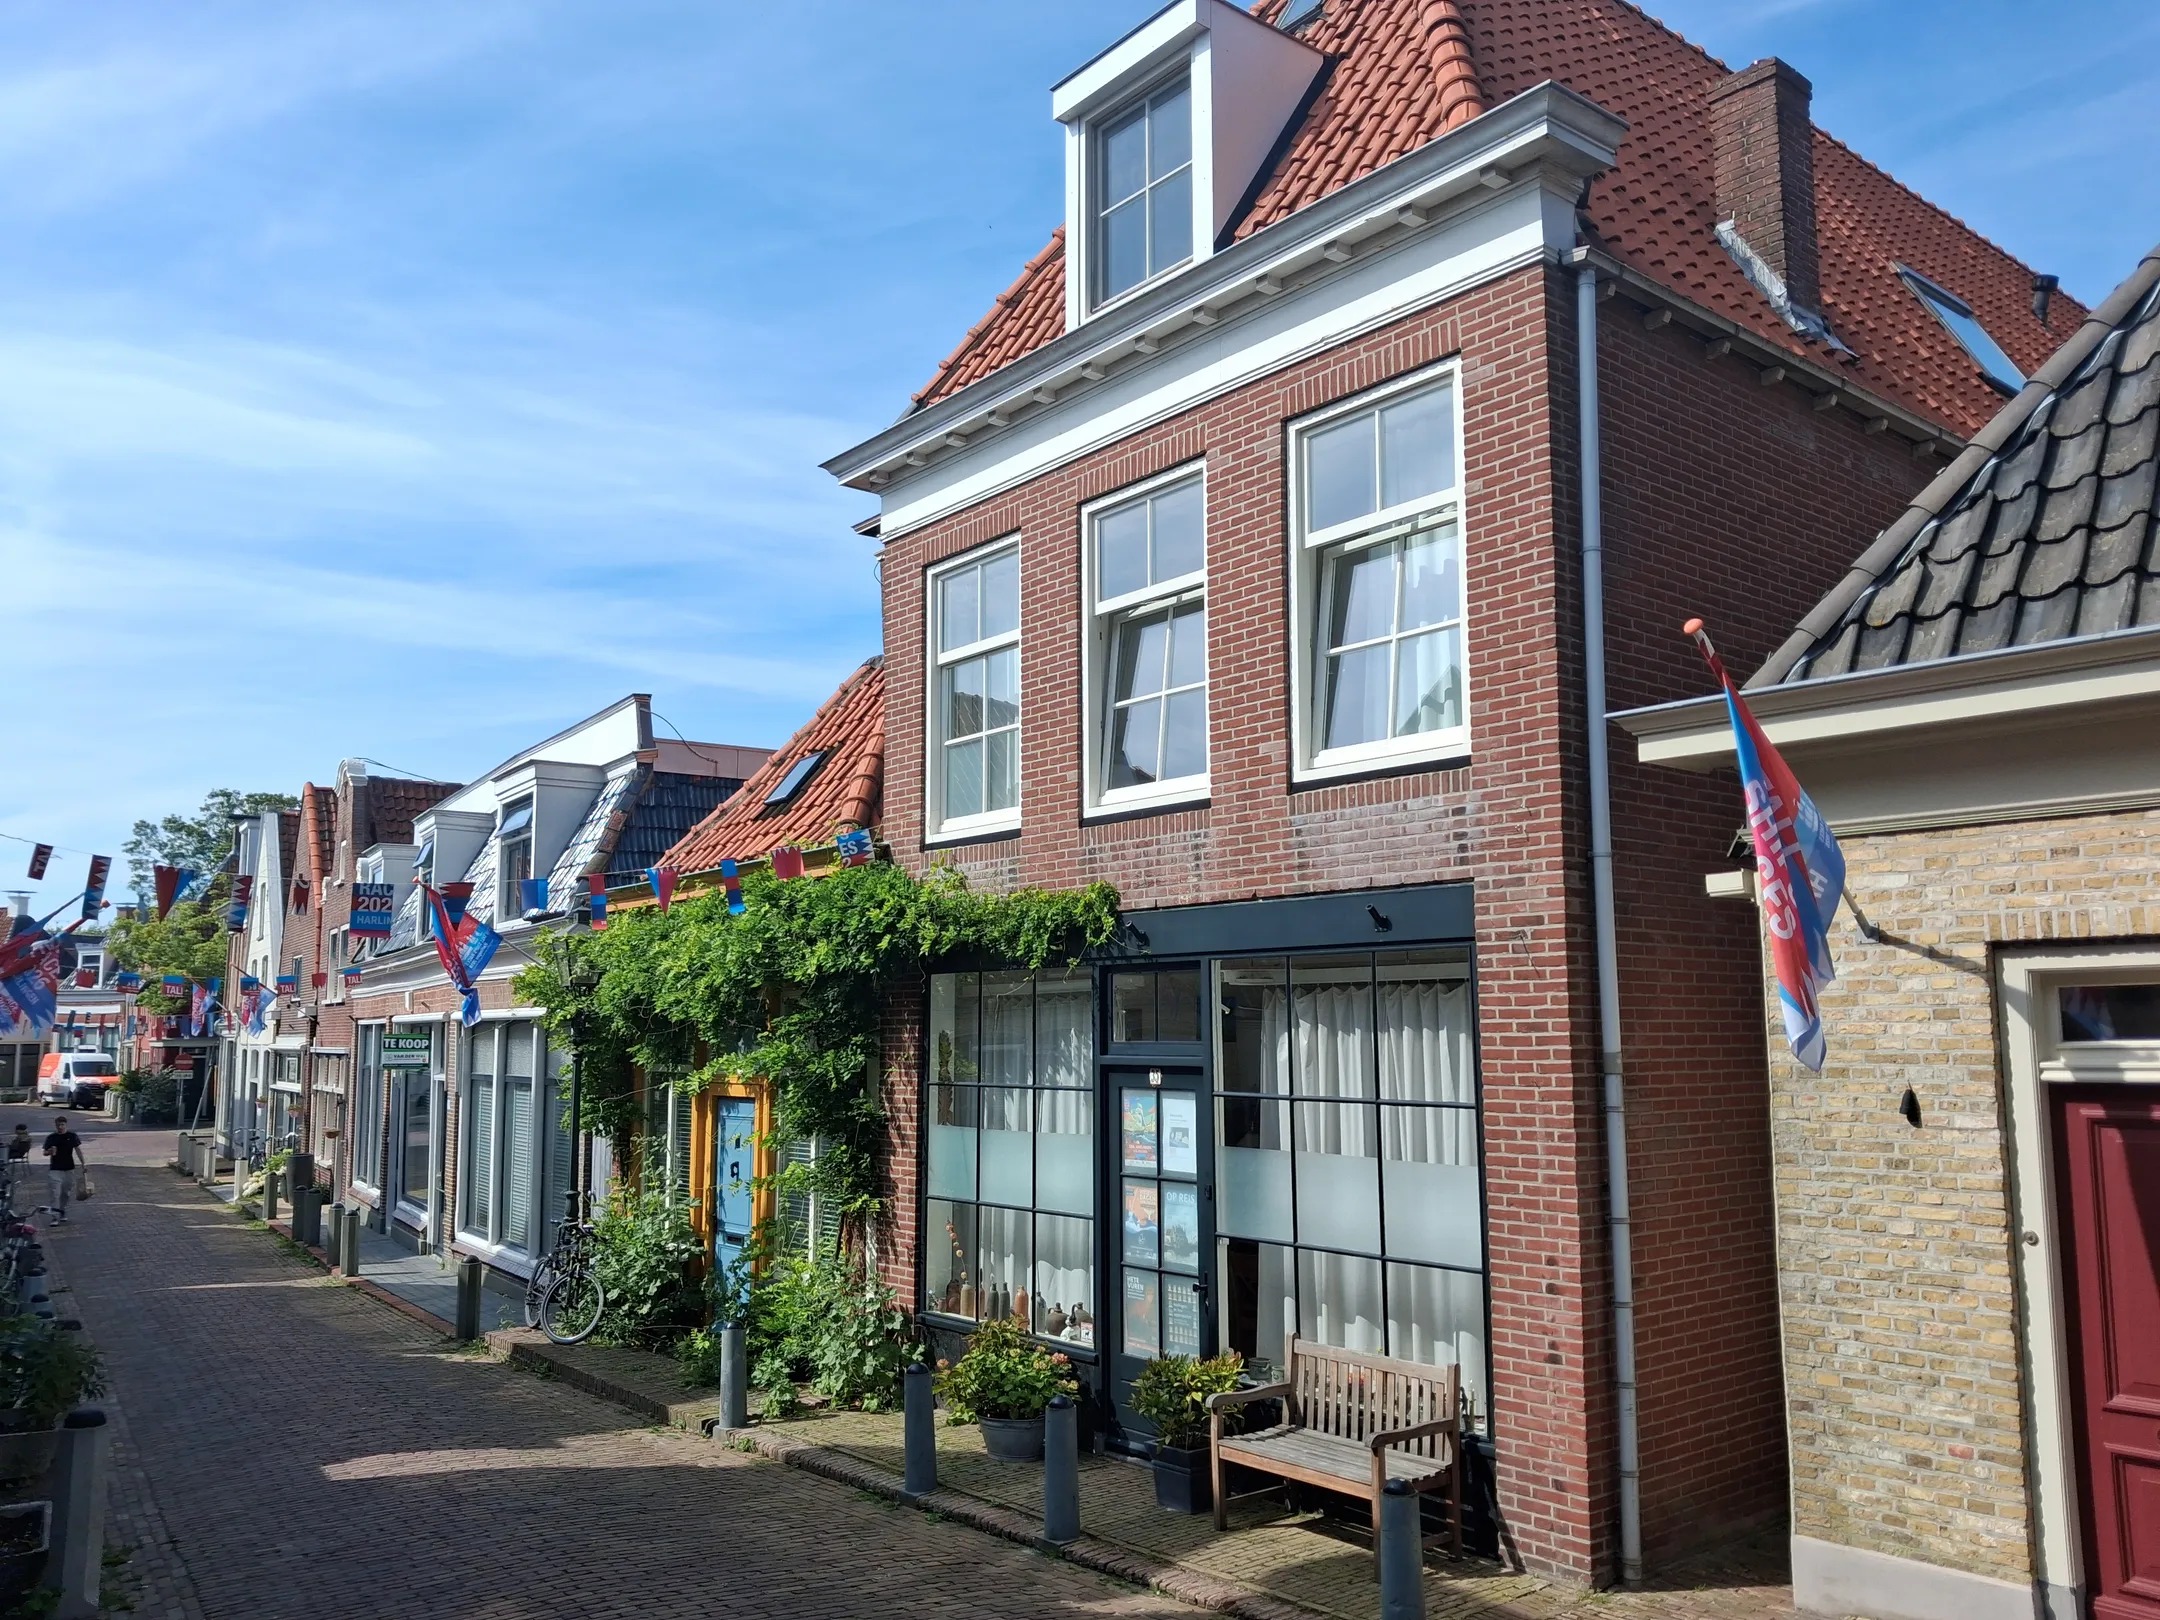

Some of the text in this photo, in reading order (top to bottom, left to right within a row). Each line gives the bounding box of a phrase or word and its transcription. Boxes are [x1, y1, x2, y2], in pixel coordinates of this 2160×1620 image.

[357, 896, 392, 913] 202
[356, 915, 392, 925] HARLIN
[384, 1038, 429, 1049] TE KOOP
[1166, 1191, 1178, 1201] OP
[1178, 1193, 1195, 1204] REIS
